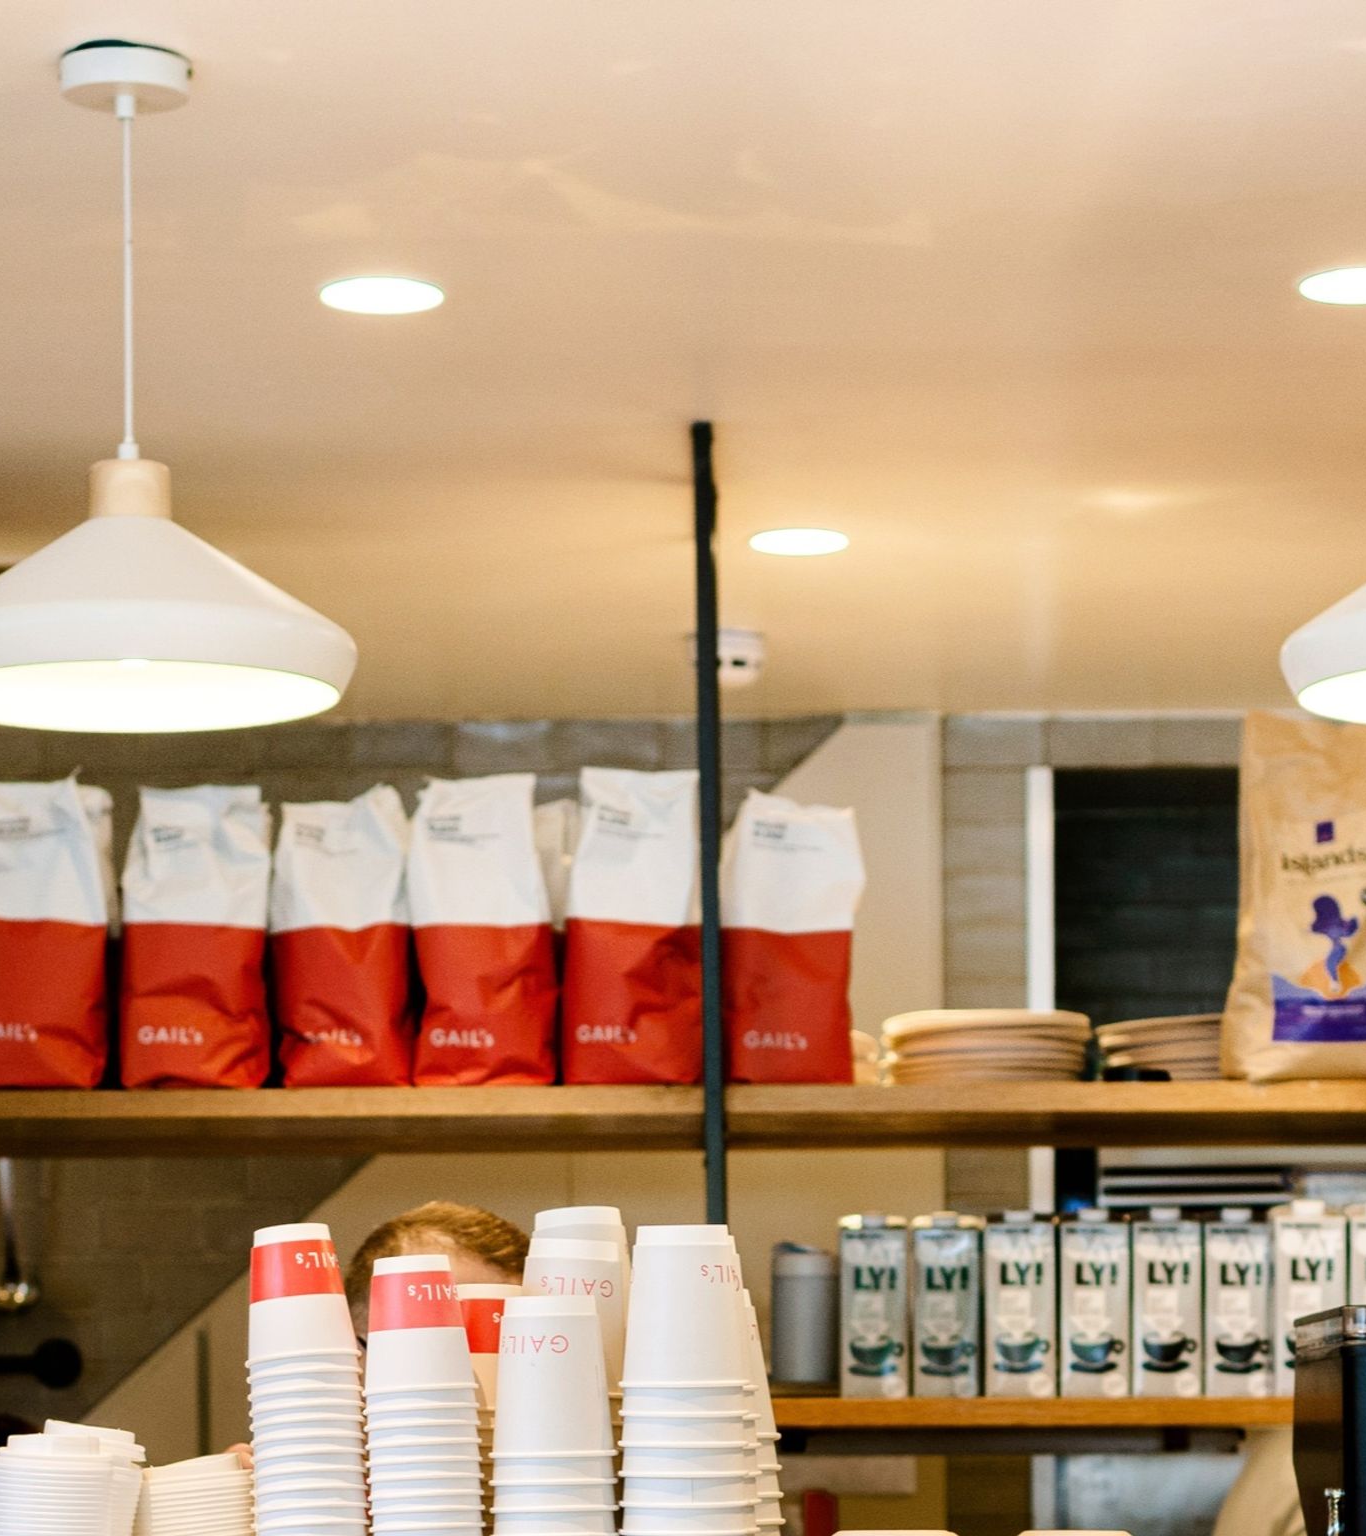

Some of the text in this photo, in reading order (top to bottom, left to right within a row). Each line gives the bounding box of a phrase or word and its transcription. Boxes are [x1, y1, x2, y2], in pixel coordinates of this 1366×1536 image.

[430, 1028, 495, 1048] GAIL's
[854, 1265, 897, 1290] LY!
[926, 1265, 970, 1291] LY!
[1000, 1262, 1043, 1286] LY!
[1075, 1262, 1117, 1287] LY!
[1147, 1261, 1190, 1285] LY!
[1220, 1263, 1262, 1286] LY!
[1291, 1258, 1334, 1282] LY!
[540, 1276, 614, 1298] GAIL's
